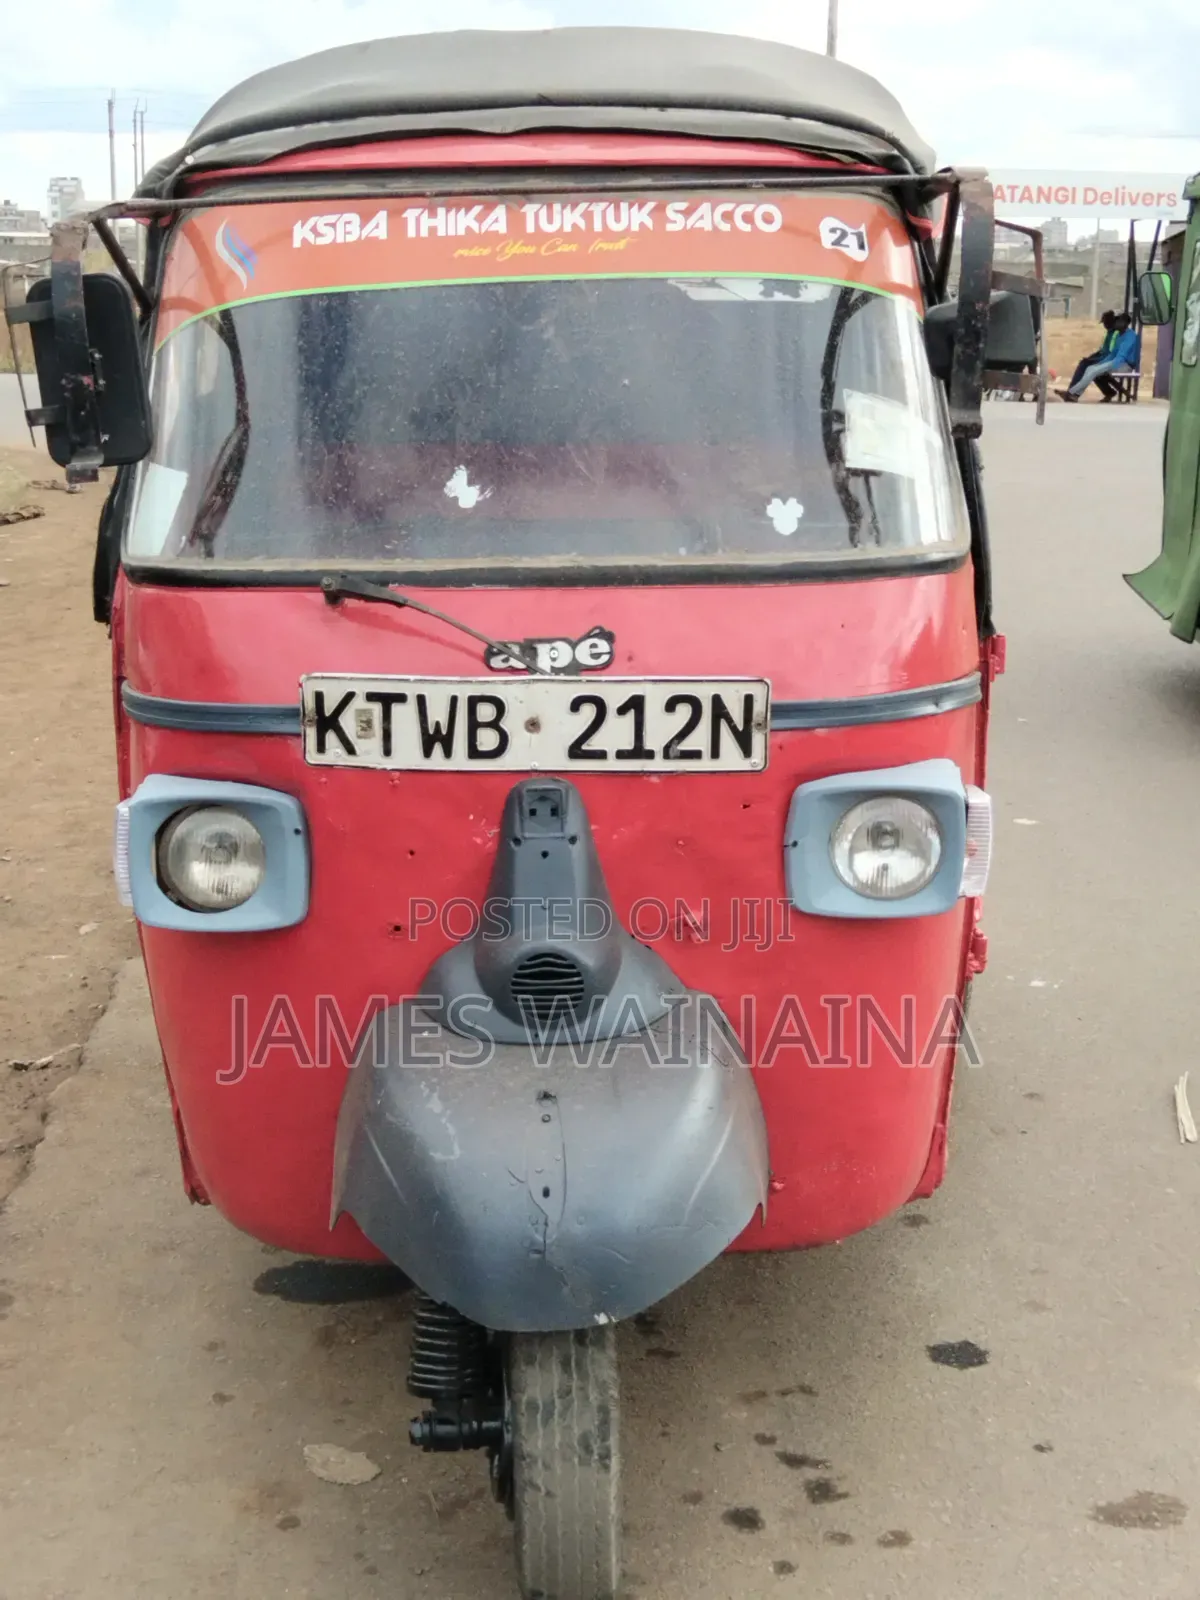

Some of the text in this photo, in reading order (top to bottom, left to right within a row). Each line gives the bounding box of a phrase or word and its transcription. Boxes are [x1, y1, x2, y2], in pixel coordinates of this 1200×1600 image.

[1083, 185, 1178, 208] Delivers
[292, 202, 783, 249] KSBA THIKA TUKTUK SACCO
[496, 238, 537, 261] You
[541, 237, 580, 256] Can
[829, 227, 866, 251] 21
[314, 690, 754, 759] KTWB 212N
